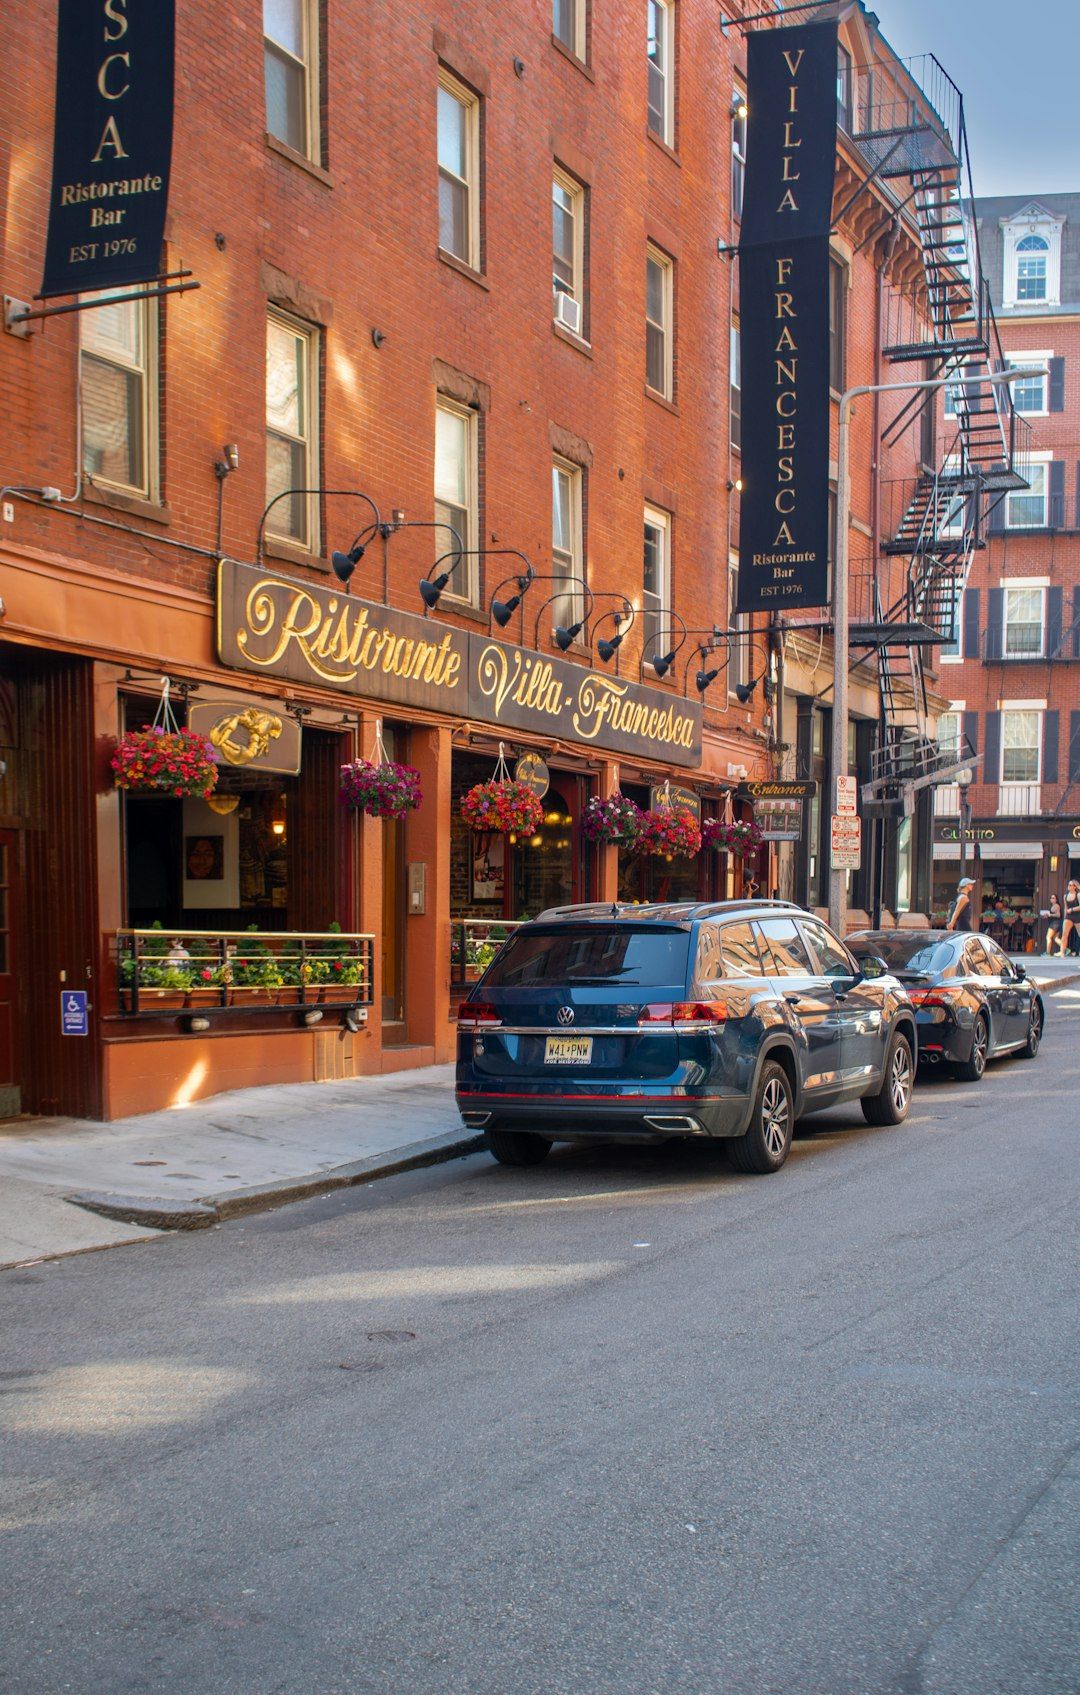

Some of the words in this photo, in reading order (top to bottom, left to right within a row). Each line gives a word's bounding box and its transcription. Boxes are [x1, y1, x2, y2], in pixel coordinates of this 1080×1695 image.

[776, 49, 806, 214] VILLA
[60, 173, 163, 208] Ristorante
[90, 207, 127, 228] Bar
[69, 242, 100, 264] EST
[103, 237, 137, 258] 1976
[772, 258, 799, 547] FRANCESCA
[752, 551, 817, 567] Ristorante
[773, 567, 796, 580] Bar
[760, 585, 780, 596] EST
[782, 584, 804, 595] 1976
[236, 577, 461, 688] Ristorante
[478, 644, 563, 718] Villa
[572, 674, 694, 748] Francesca
[747, 782, 806, 796] Entrance
